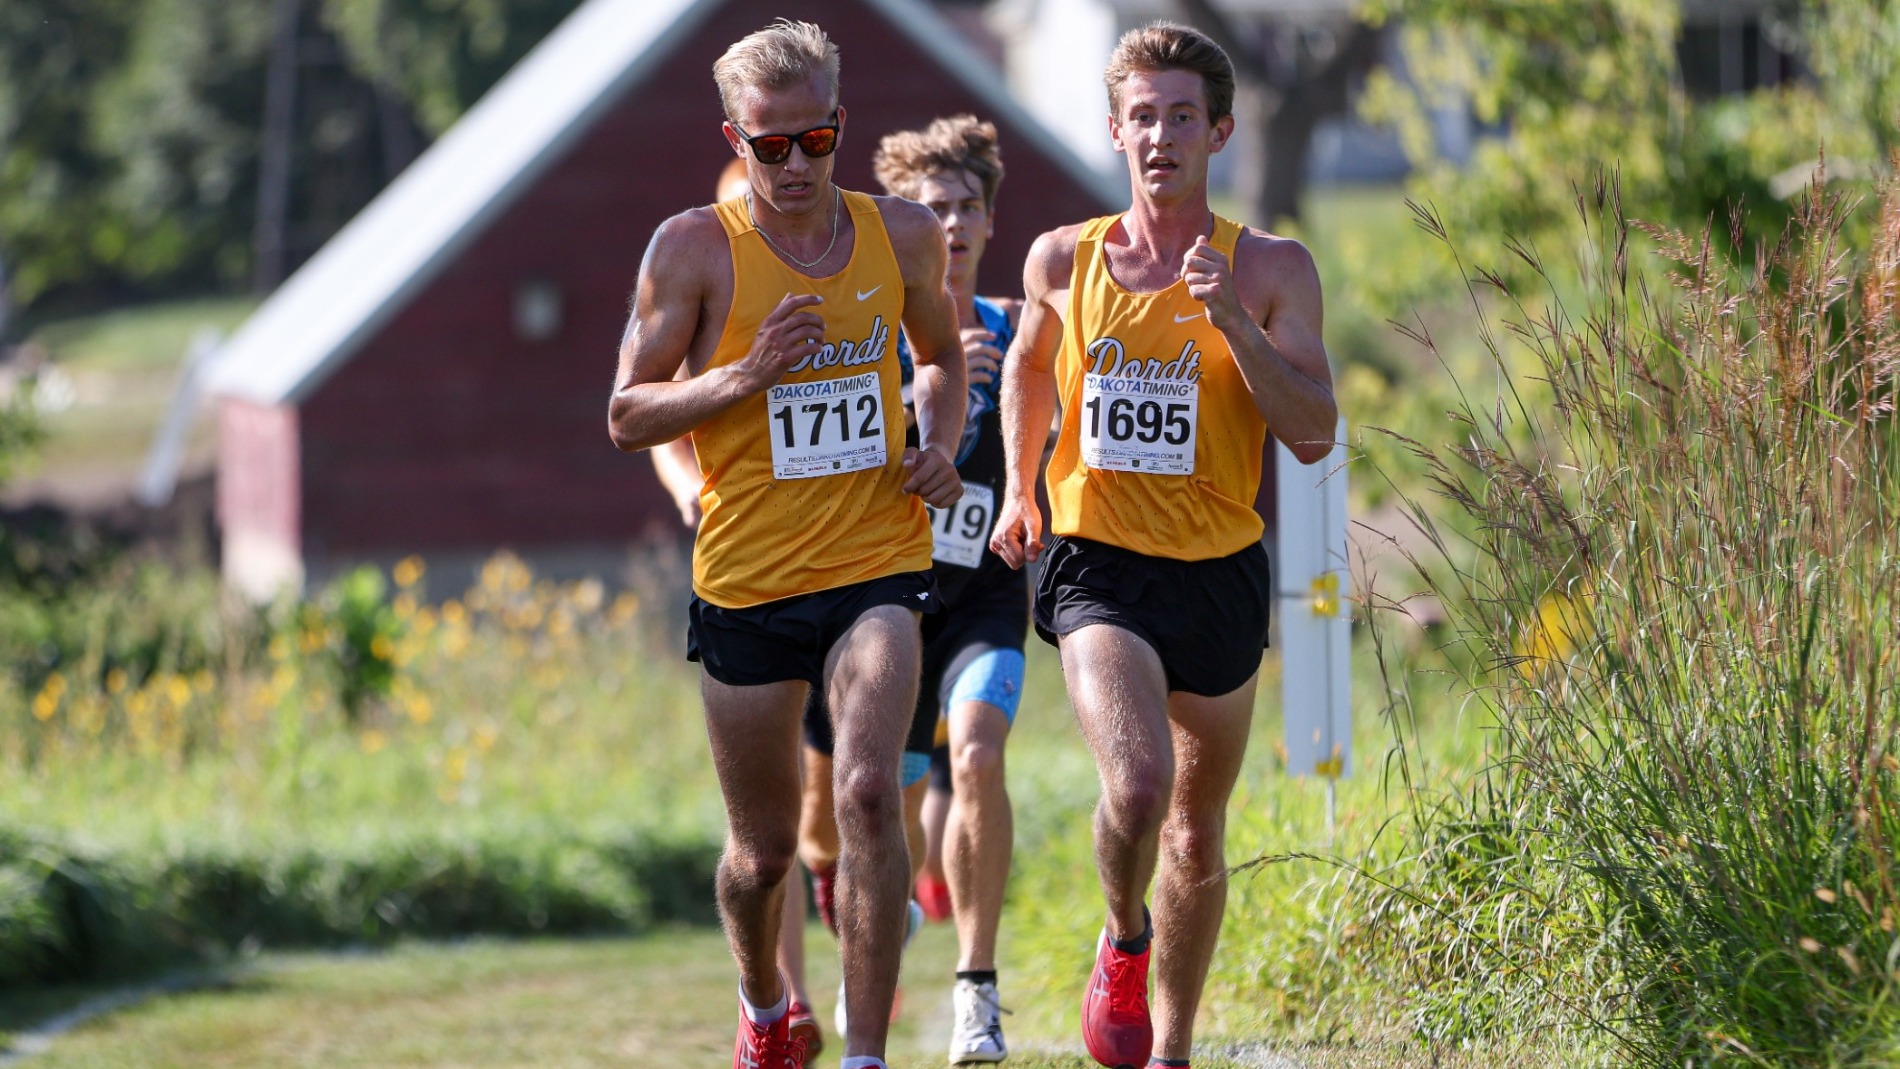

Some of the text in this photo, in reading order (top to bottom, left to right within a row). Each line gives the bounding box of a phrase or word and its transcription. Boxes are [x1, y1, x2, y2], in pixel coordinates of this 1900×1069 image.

[787, 315, 889, 373] ordt
[1087, 336, 1202, 384] Dordt
[774, 394, 880, 448] 1712
[1086, 396, 1191, 446] 1695
